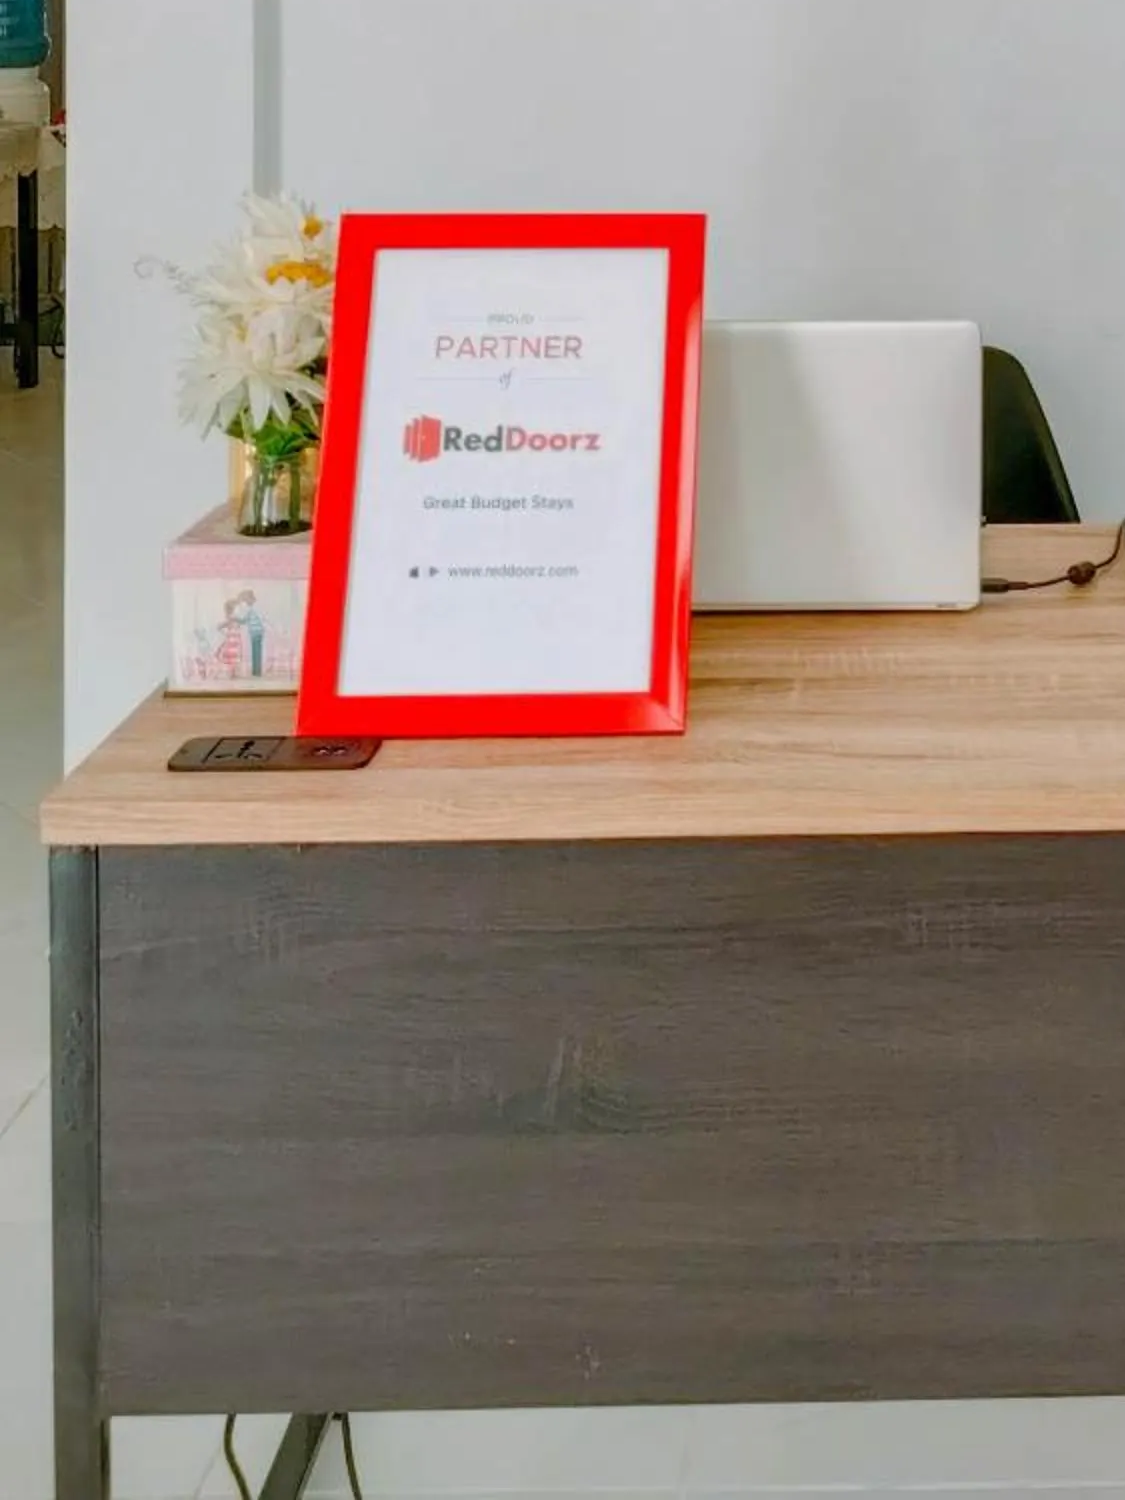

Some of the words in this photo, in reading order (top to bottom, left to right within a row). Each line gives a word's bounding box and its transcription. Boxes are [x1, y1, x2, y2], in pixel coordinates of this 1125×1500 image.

[435, 335, 583, 359] PARTNER
[443, 425, 601, 452] RedDoorz
[423, 495, 466, 510] Great
[470, 493, 527, 512] Budget
[531, 494, 575, 512] Stays
[448, 564, 579, 578] www.reddoorz.com
